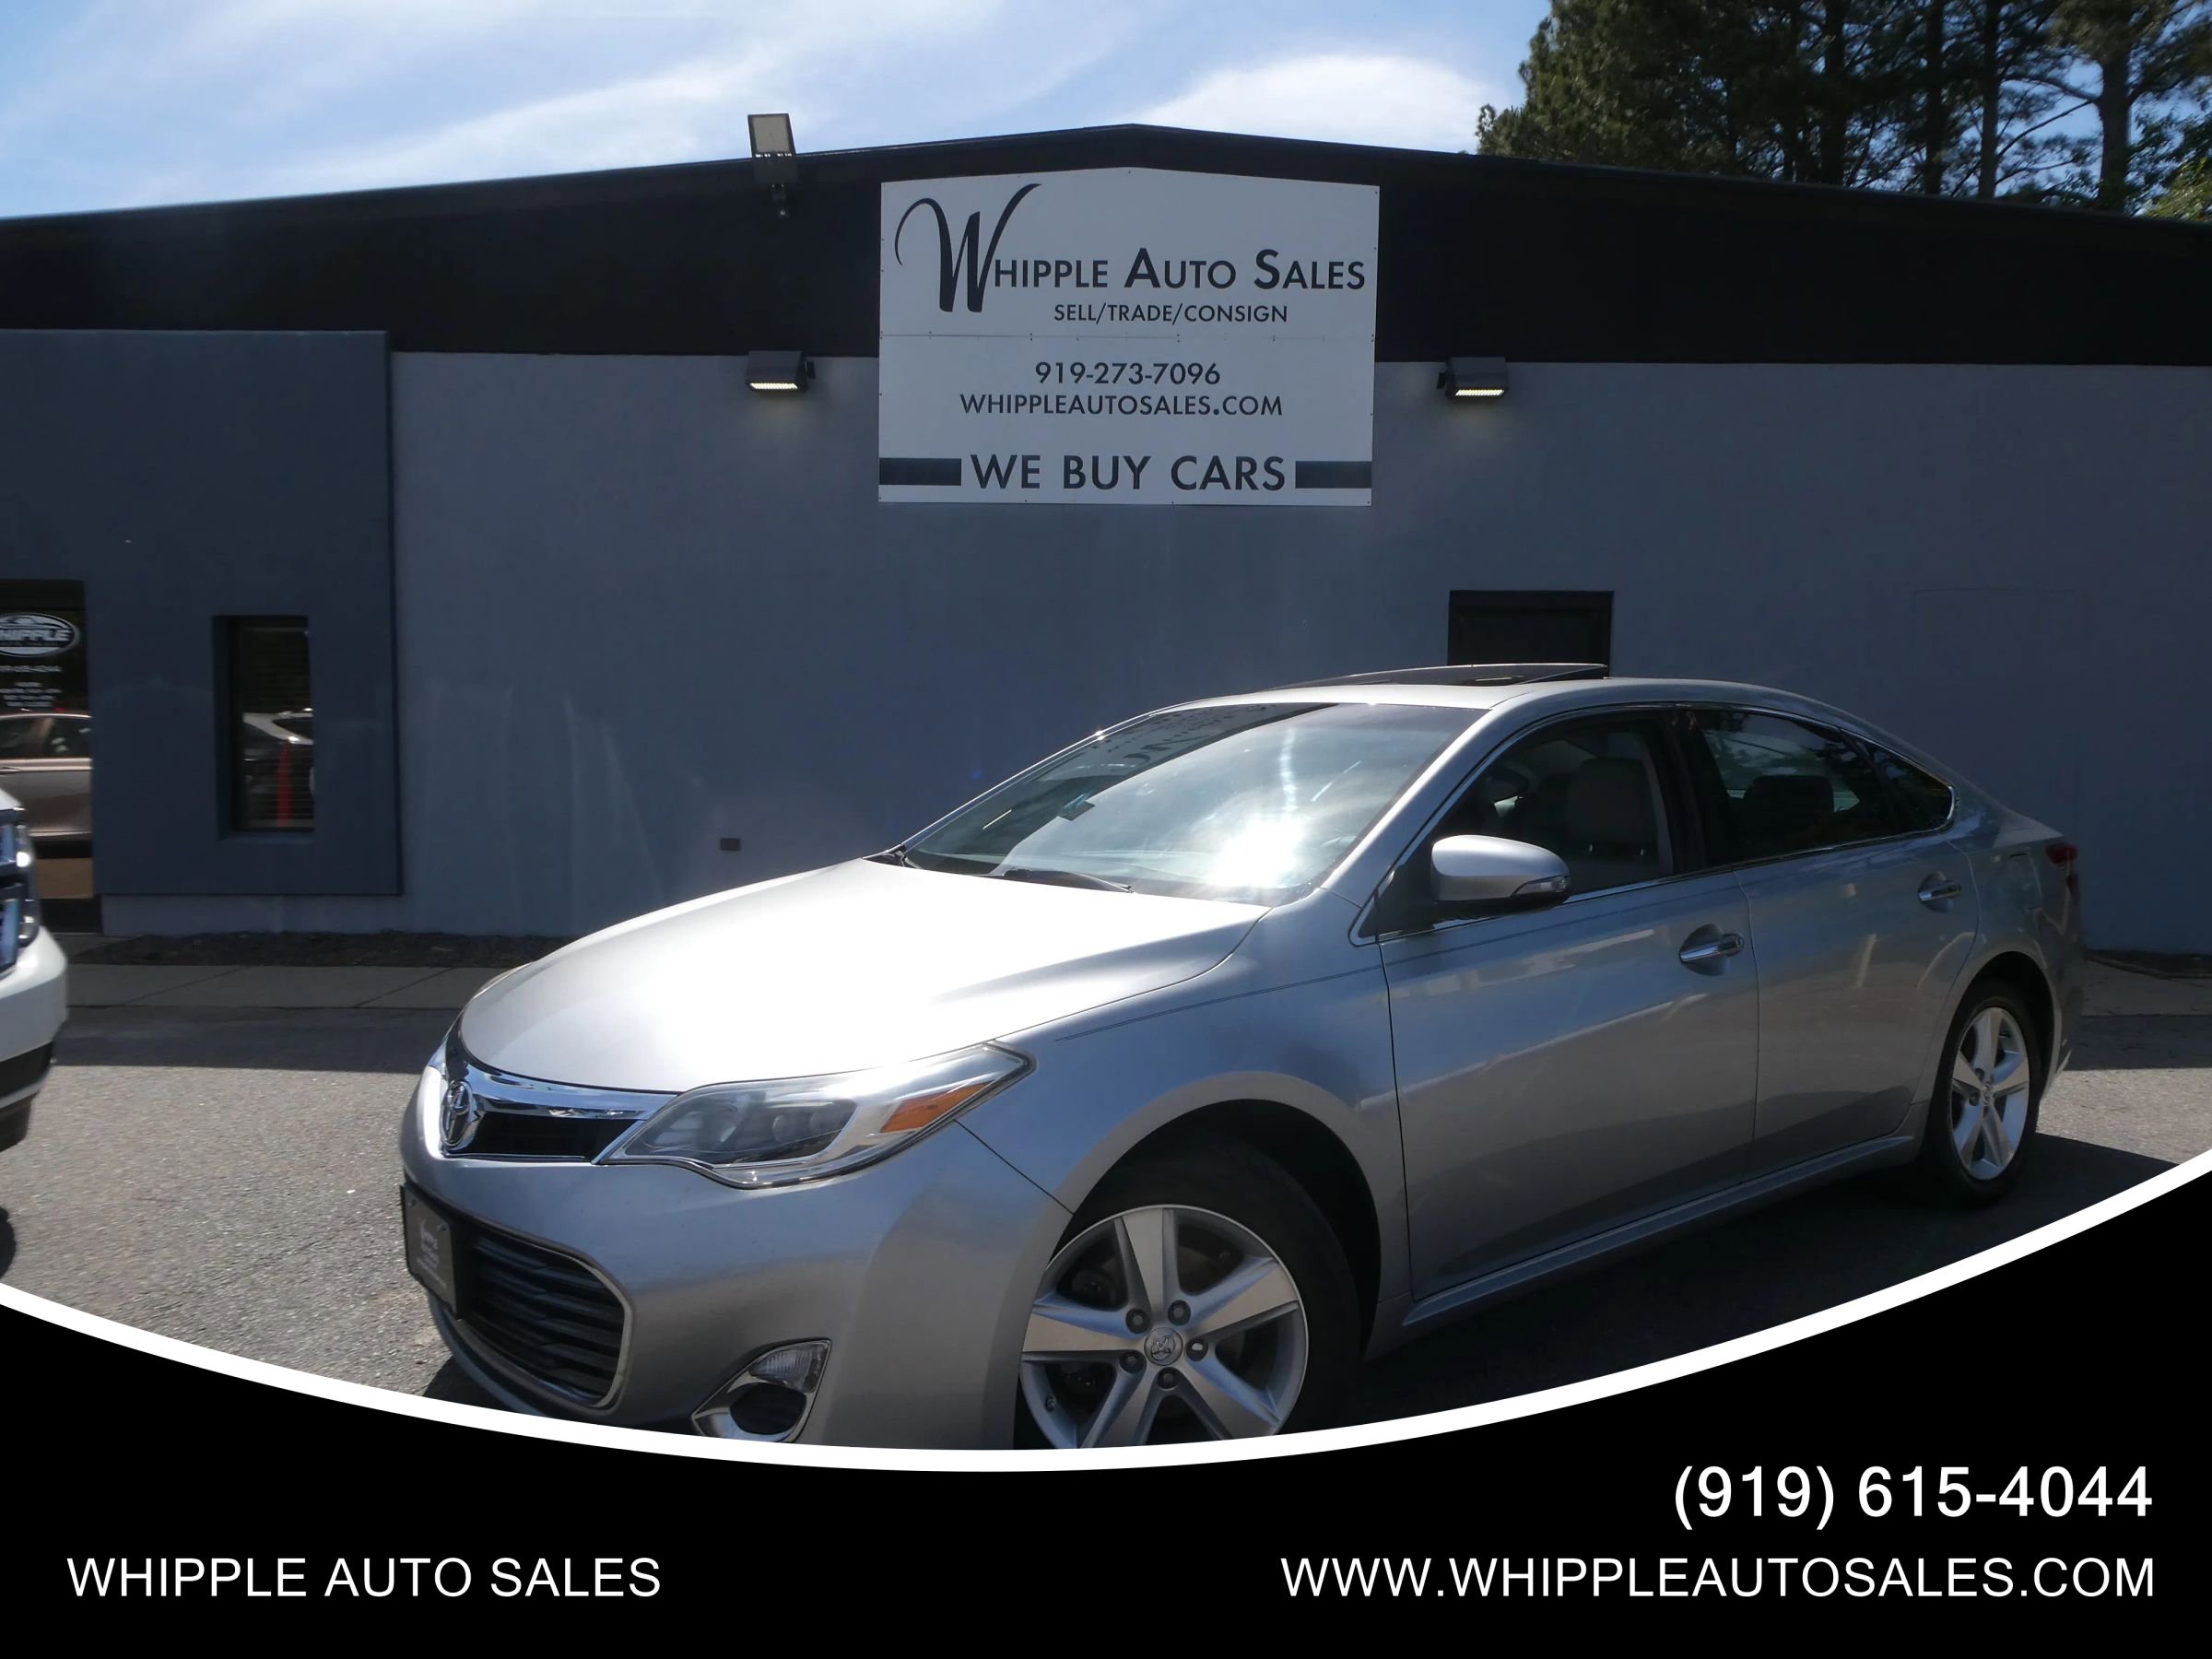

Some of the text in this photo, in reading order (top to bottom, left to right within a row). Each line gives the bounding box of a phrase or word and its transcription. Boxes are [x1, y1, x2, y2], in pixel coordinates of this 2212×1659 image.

[1124, 247, 1237, 289] AUTO
[1253, 249, 1366, 290] SALES
[1053, 302, 1288, 325] SELL/TRADE/CONSIGN
[1035, 361, 1221, 385] 919-273-7096
[960, 394, 1283, 417] WHIPPLEAUTOSALES.COM
[971, 454, 1287, 491] WE BUY CARS
